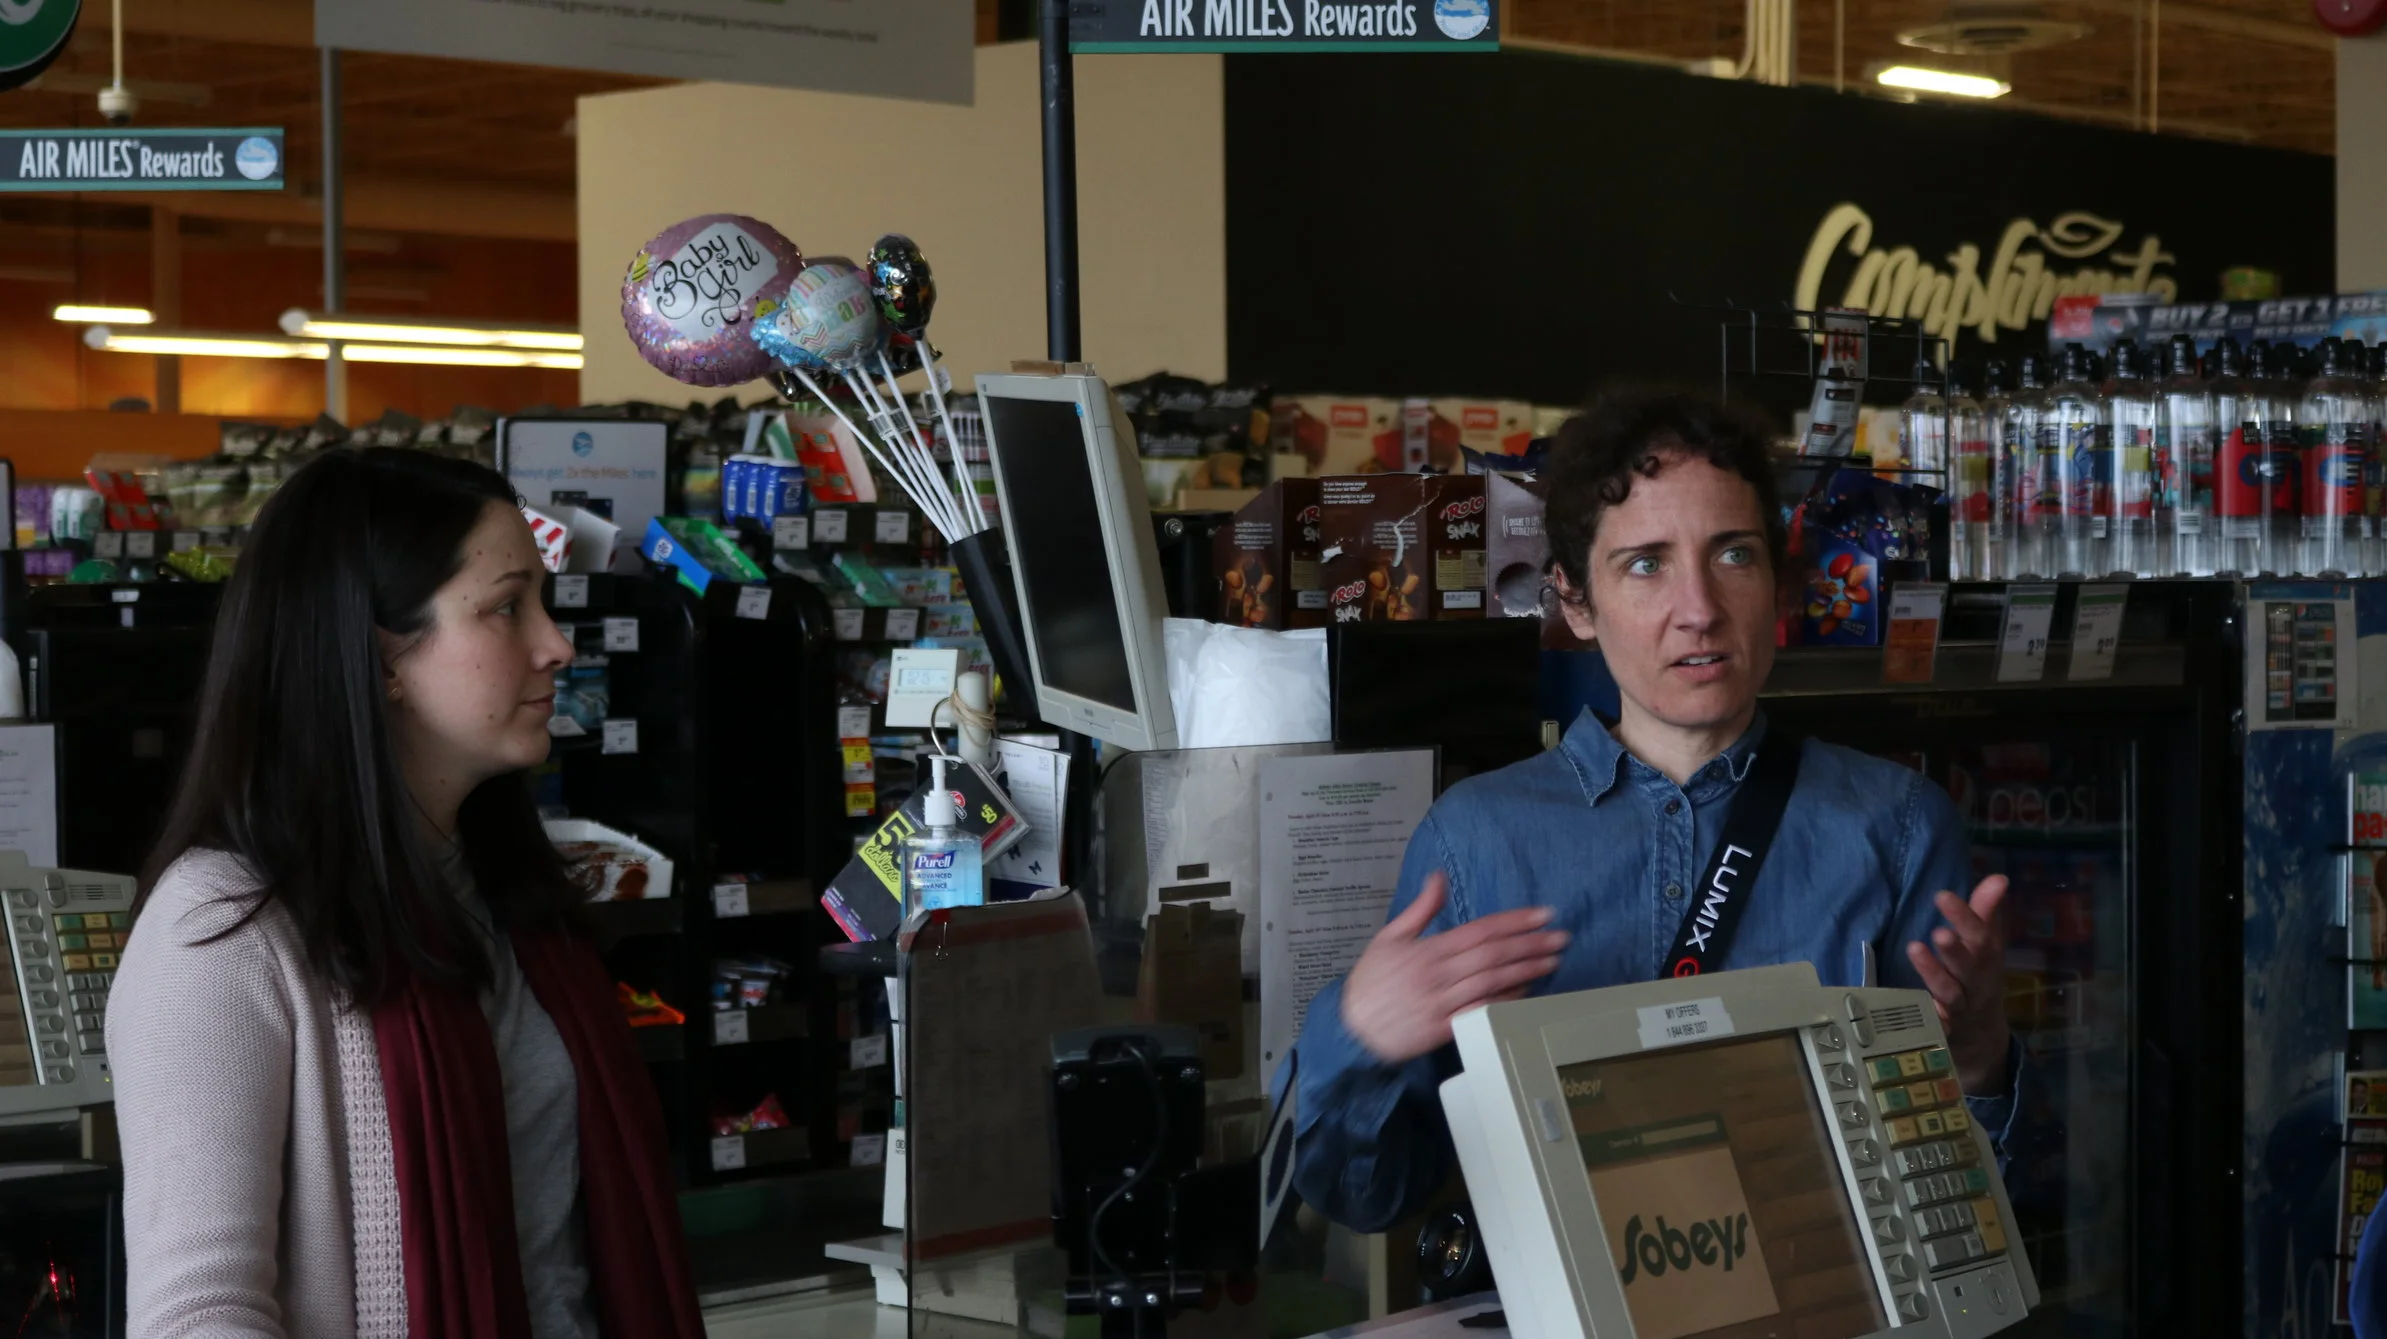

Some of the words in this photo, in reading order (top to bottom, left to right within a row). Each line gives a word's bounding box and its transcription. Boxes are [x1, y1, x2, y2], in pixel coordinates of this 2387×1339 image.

[1139, 0, 1195, 37] AIR
[1203, 0, 1295, 37] MILES
[1304, 0, 1418, 37] Rewards
[19, 138, 60, 178] AIR
[140, 140, 225, 178] Rewards
[652, 234, 730, 321] Baby
[2151, 305, 2209, 328] BUY
[2209, 303, 2230, 326] 2
[2256, 300, 2313, 323] GET
[980, 803, 999, 825] $50
[1987, 773, 2097, 842] pepsi
[917, 853, 953, 869] Purell
[917, 871, 953, 881] ADVANCED
[1685, 843, 1753, 953] LUMIX
[1664, 1007, 1676, 1020] MY
[1675, 1003, 1701, 1018] OFFERS
[1620, 1211, 1749, 1287] Sobeys
